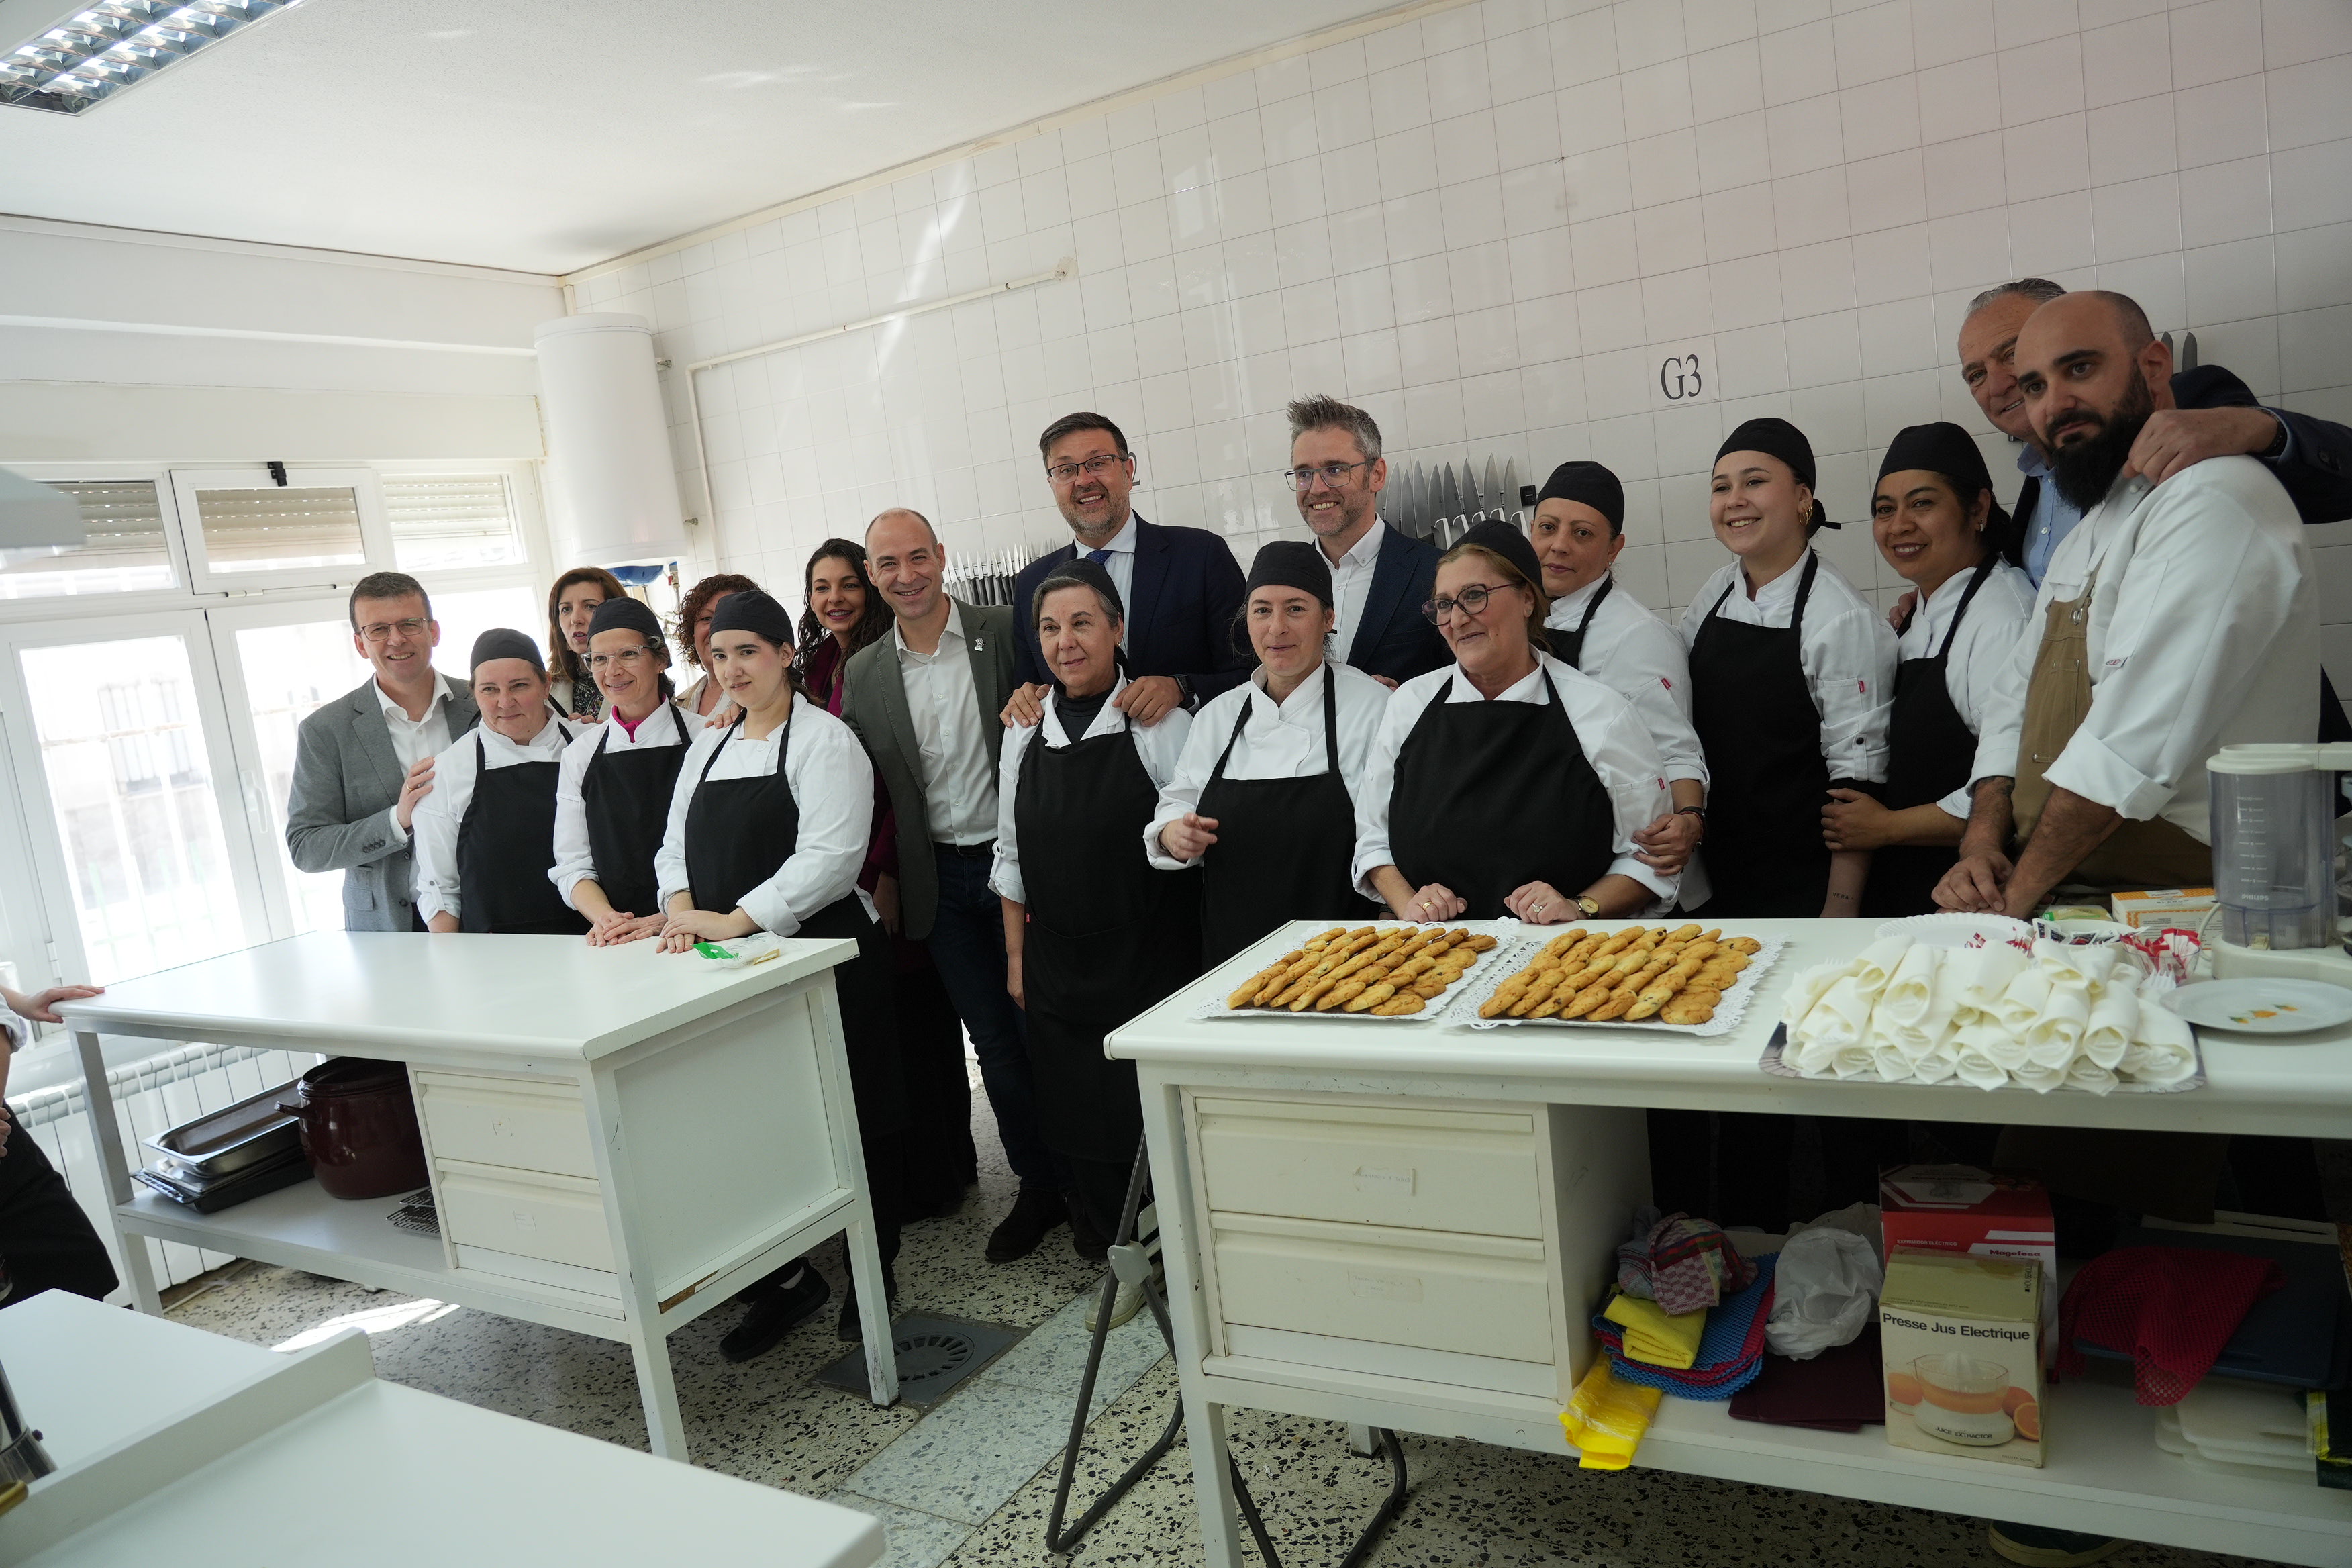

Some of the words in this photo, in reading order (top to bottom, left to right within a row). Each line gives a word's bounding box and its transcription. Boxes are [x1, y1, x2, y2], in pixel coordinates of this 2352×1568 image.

[1661, 354, 1702, 400] G3
[1883, 1312, 1928, 1330] Presse
[1931, 1322, 1956, 1334] Jus
[1961, 1325, 2030, 1342] Electrique
[1935, 1426, 1952, 1435] JUICE
[1954, 1431, 1992, 1439] EXTRACTOR
